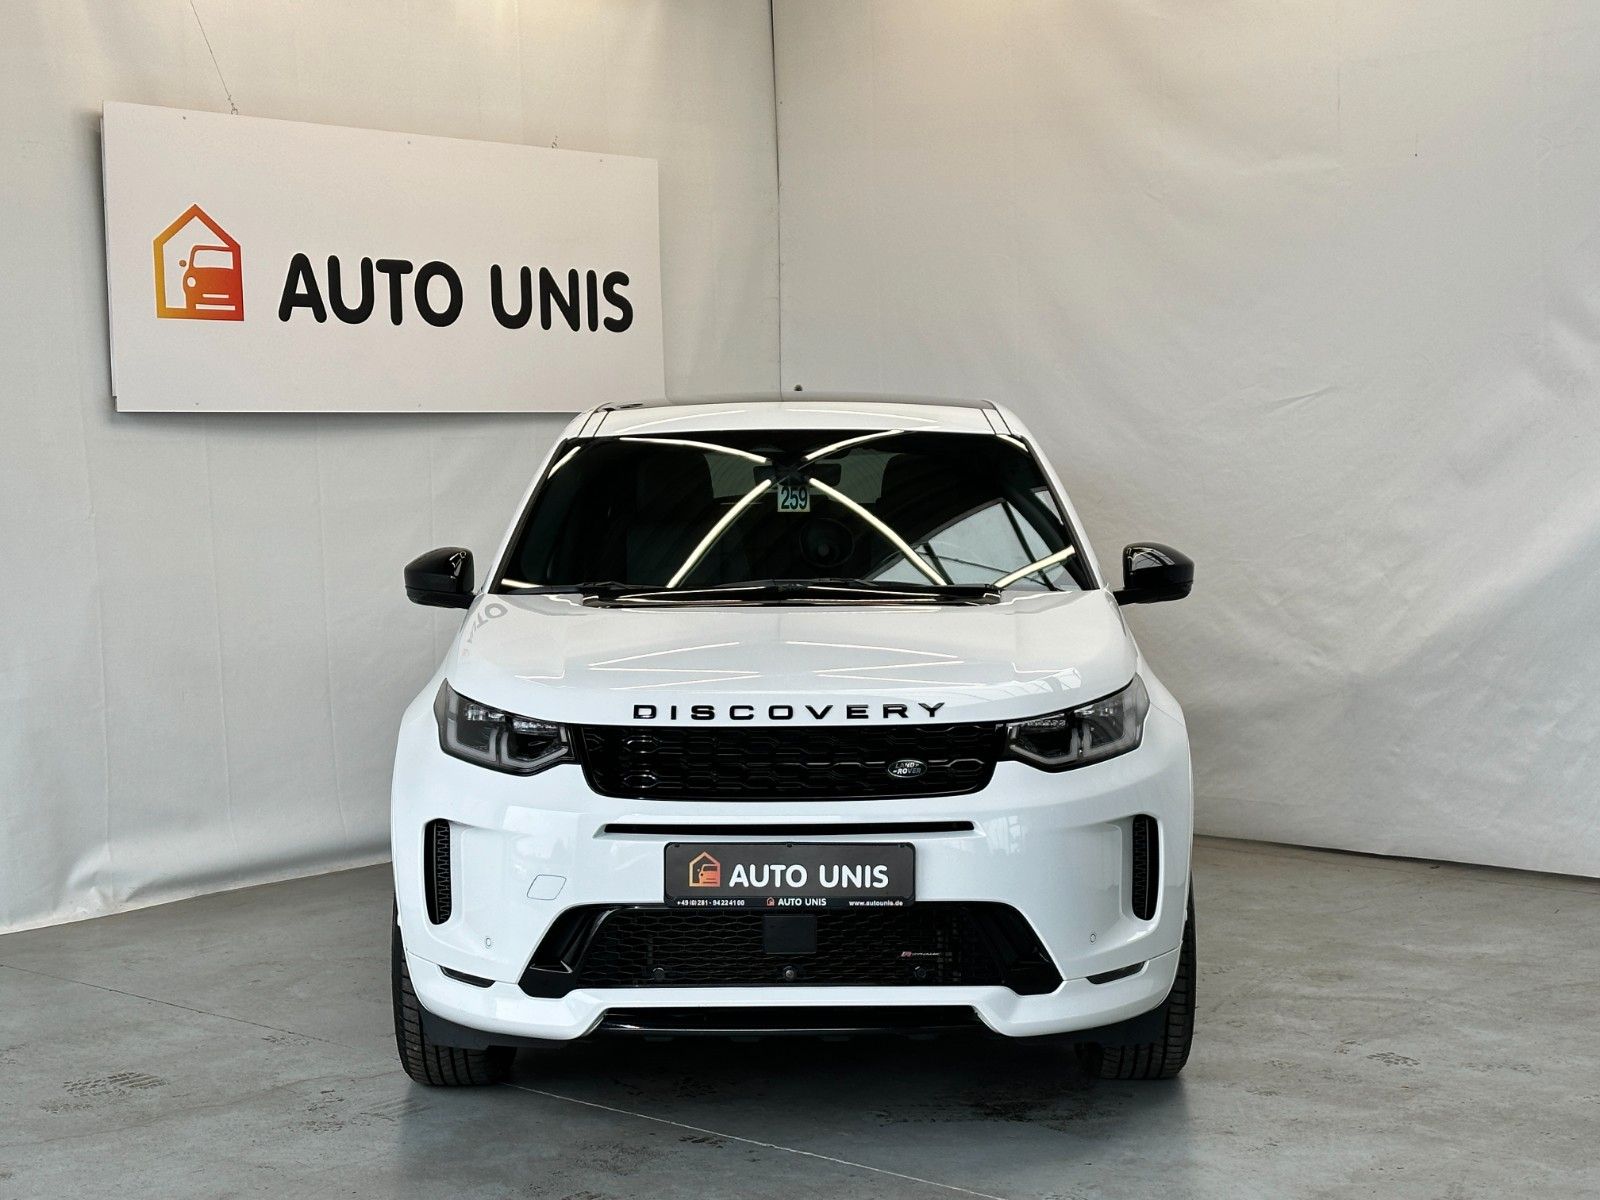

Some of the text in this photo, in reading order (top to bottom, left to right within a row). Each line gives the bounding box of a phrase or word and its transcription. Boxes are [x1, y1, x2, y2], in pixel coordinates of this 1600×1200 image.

[278, 252, 634, 333] AUTO UNIS
[780, 485, 808, 510] 259
[633, 702, 945, 720] DISCOVERY
[728, 864, 889, 888] AUTO UNIS
[777, 898, 827, 907] AUTO UNIS
[848, 899, 904, 907] www.autounis.de
